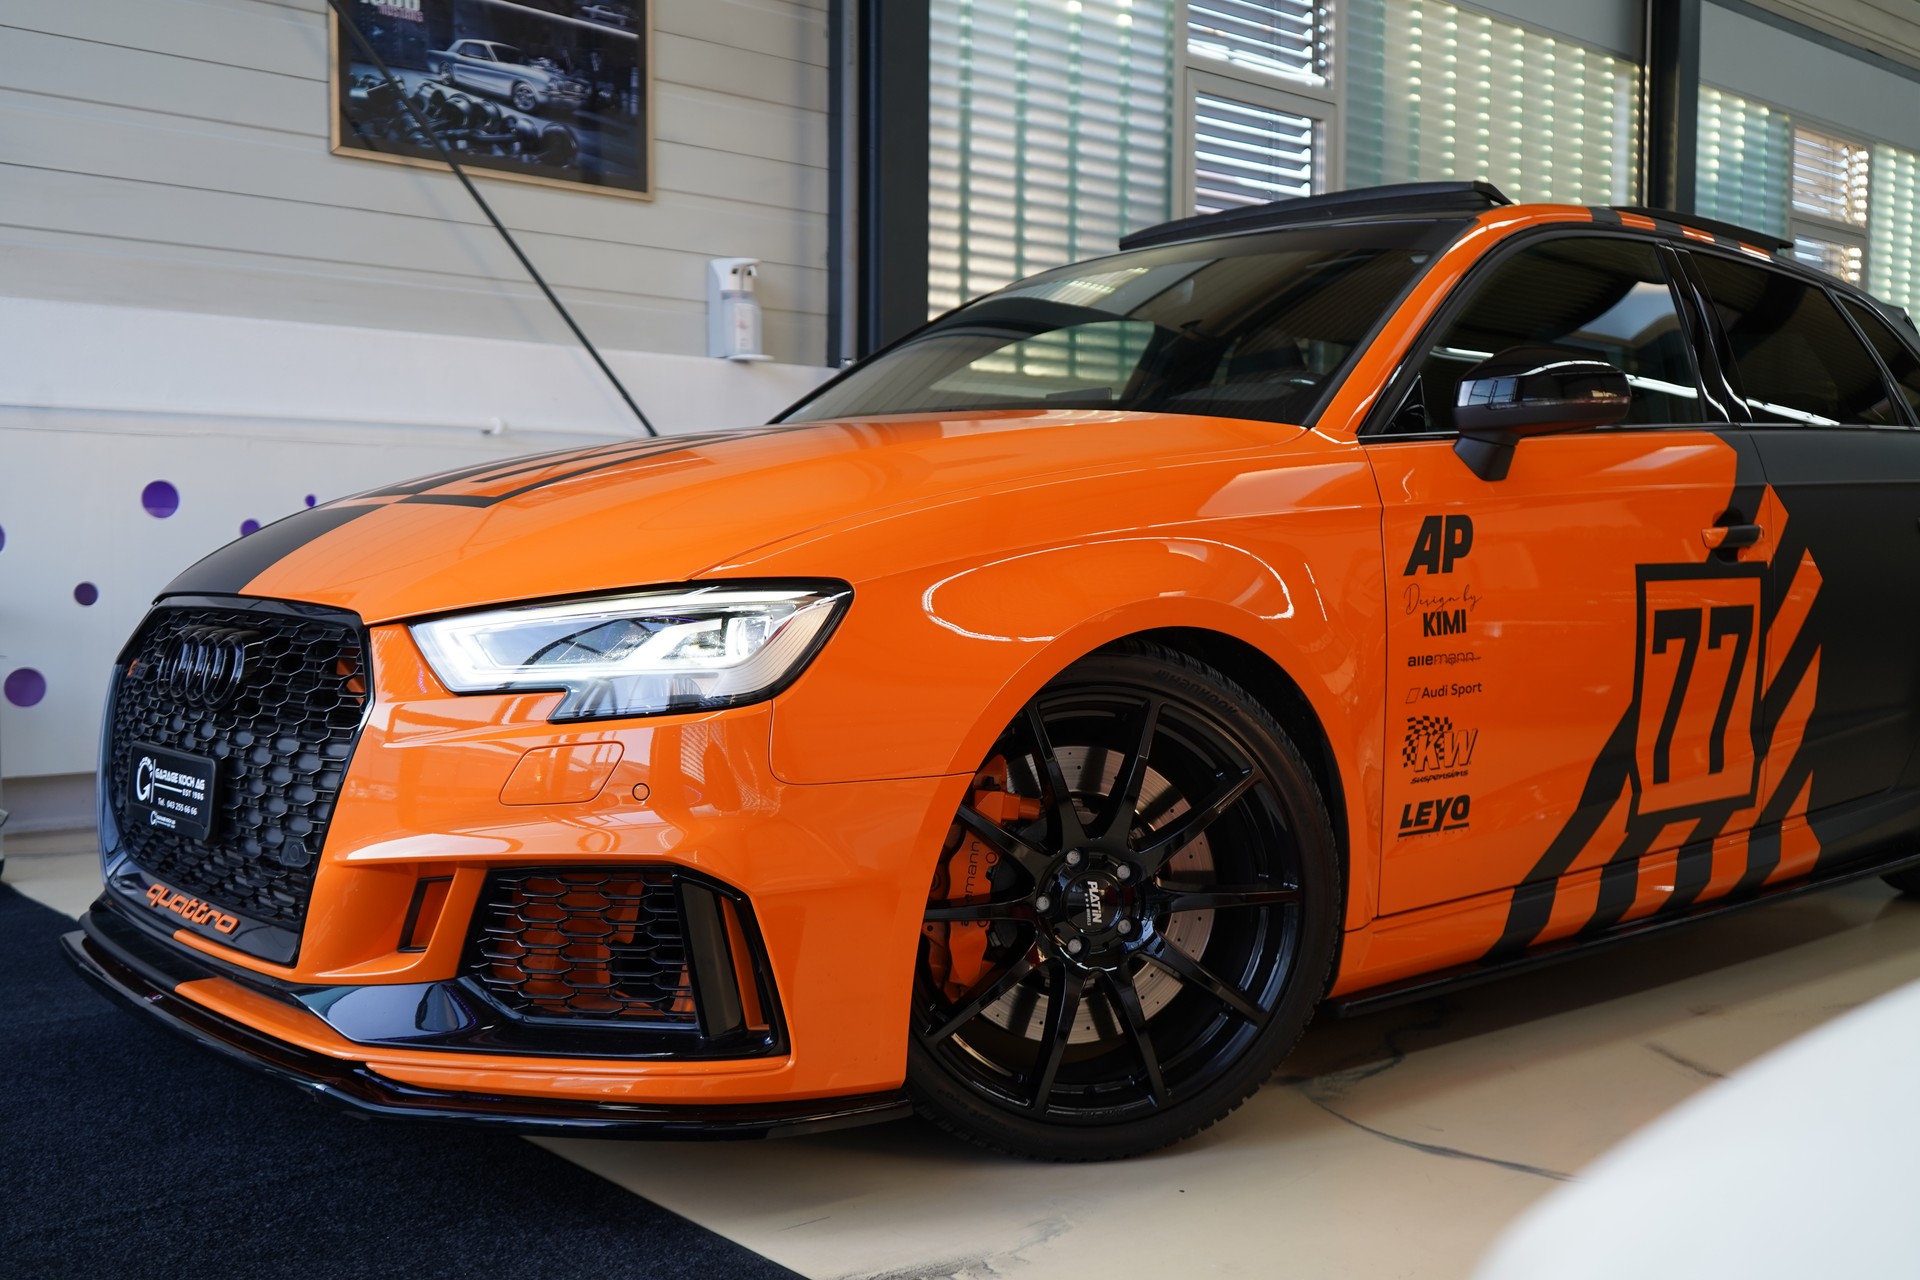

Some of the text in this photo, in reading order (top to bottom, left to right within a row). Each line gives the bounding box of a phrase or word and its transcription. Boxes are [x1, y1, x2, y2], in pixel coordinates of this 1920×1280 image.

[1403, 514, 1474, 576] AP
[1403, 583, 1482, 615] Design by
[1423, 609, 1466, 637] KIMI
[1421, 682, 1483, 699] Audi Sport
[1652, 604, 1754, 785] 77
[1414, 727, 1479, 773] KW
[155, 768, 206, 791] GARAGE KOCH AG
[1400, 794, 1471, 832] LEYO
[146, 883, 239, 934] quattro
